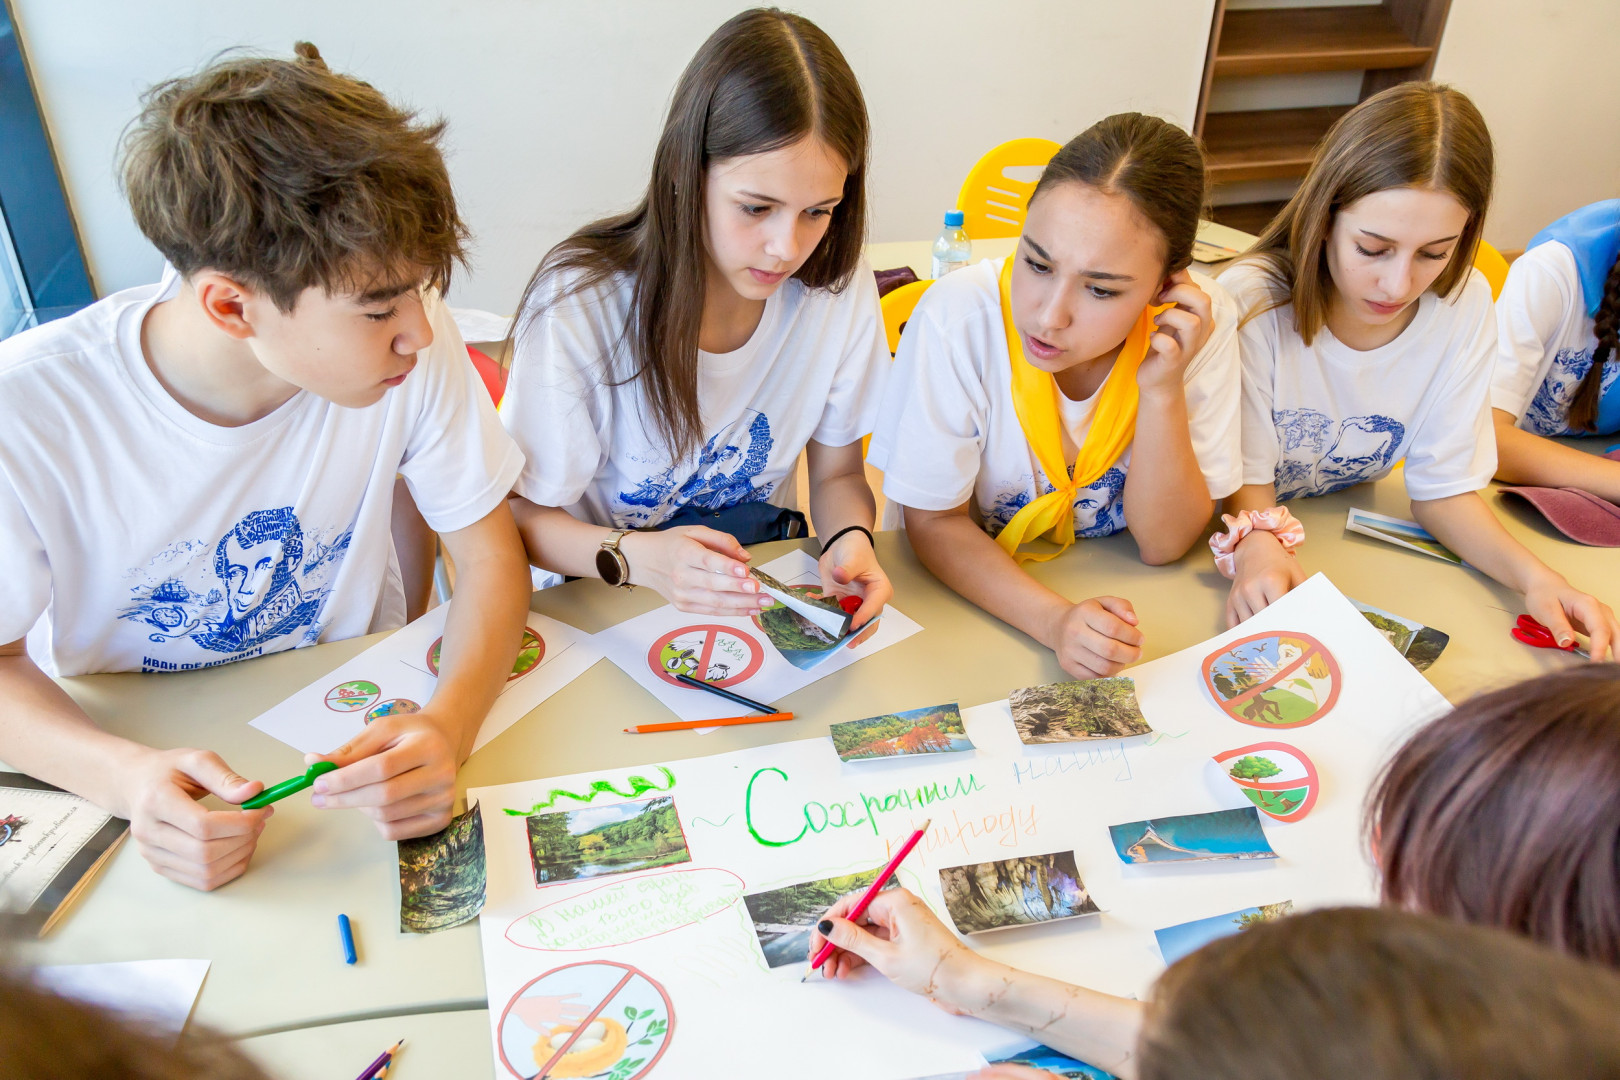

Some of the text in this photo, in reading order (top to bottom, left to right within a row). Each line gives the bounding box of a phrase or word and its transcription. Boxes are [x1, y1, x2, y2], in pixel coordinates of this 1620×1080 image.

[142, 655, 178, 671] ИВАН
[745, 741, 1133, 848] Сохраним нашу
